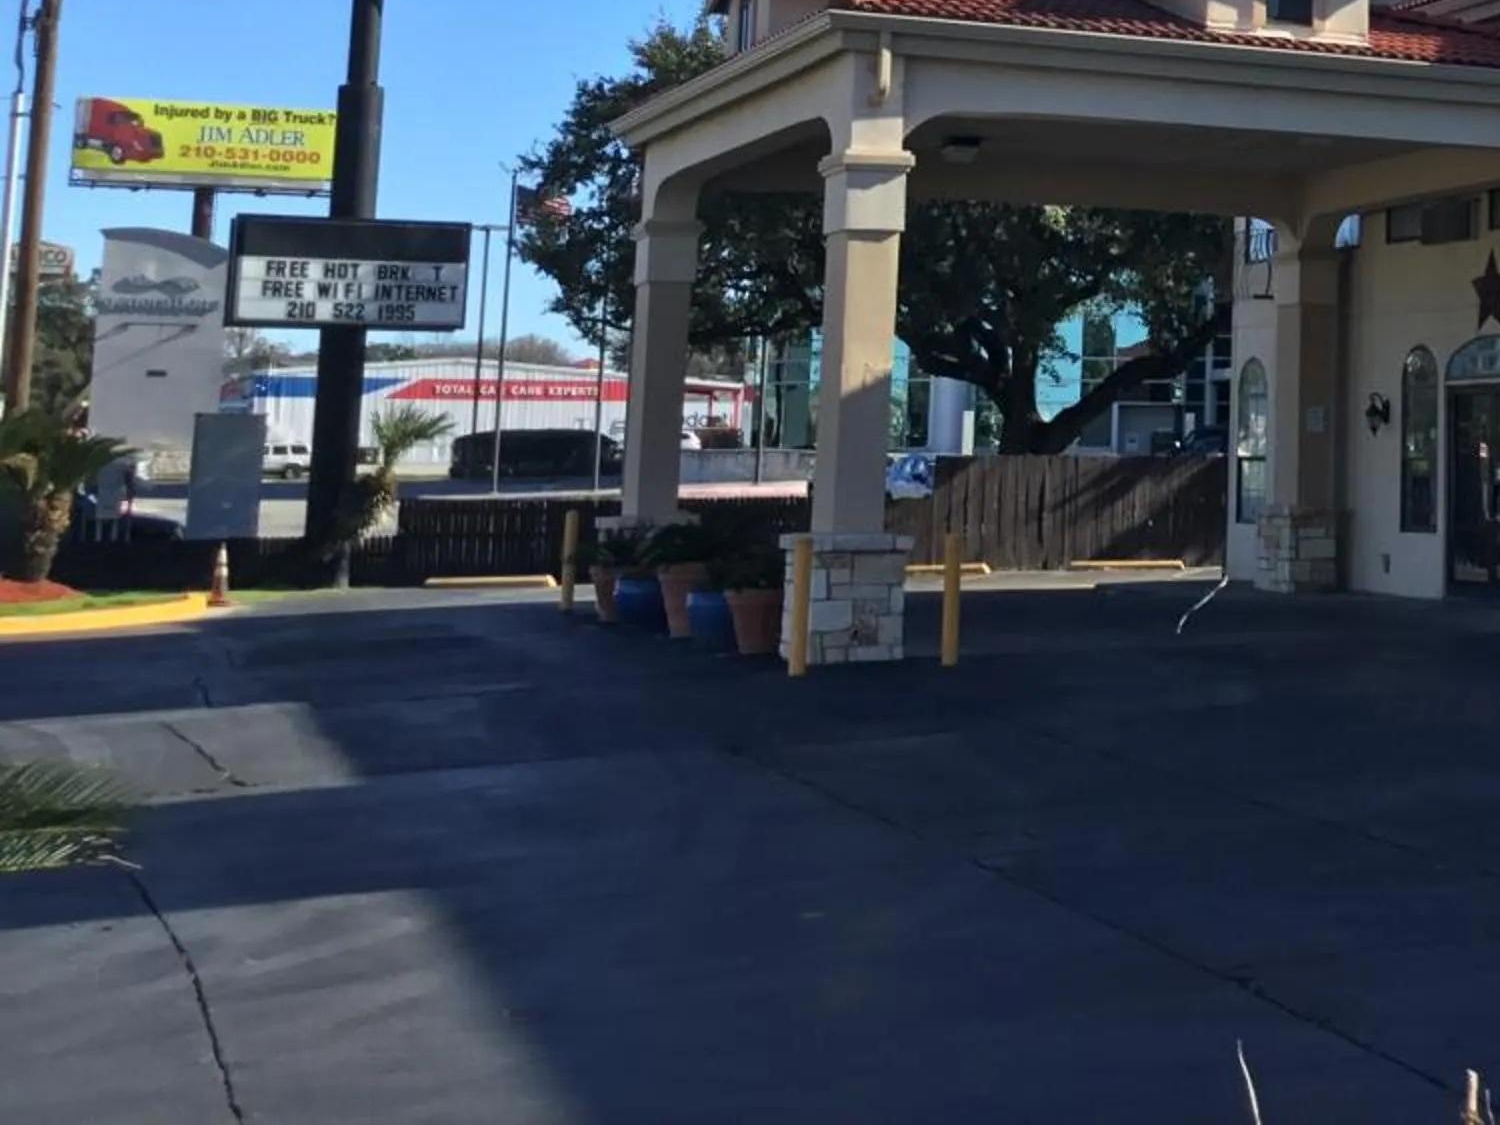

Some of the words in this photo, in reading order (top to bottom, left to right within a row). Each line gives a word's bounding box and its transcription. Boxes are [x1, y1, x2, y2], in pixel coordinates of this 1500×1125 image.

[154, 104, 210, 120] Injured
[213, 107, 233, 123] by
[236, 110, 247, 120] a
[251, 109, 278, 124] BIG
[197, 125, 232, 144] JIM
[239, 126, 305, 146] ADLER
[266, 259, 310, 278] FREE
[323, 262, 360, 279] HOT
[262, 280, 305, 298] FREE
[374, 283, 459, 301] INTERNET
[286, 300, 316, 318] 210
[332, 302, 366, 320] 522
[378, 303, 416, 321] 1995
[434, 384, 473, 395] TOTAL
[479, 384, 506, 396] CA
